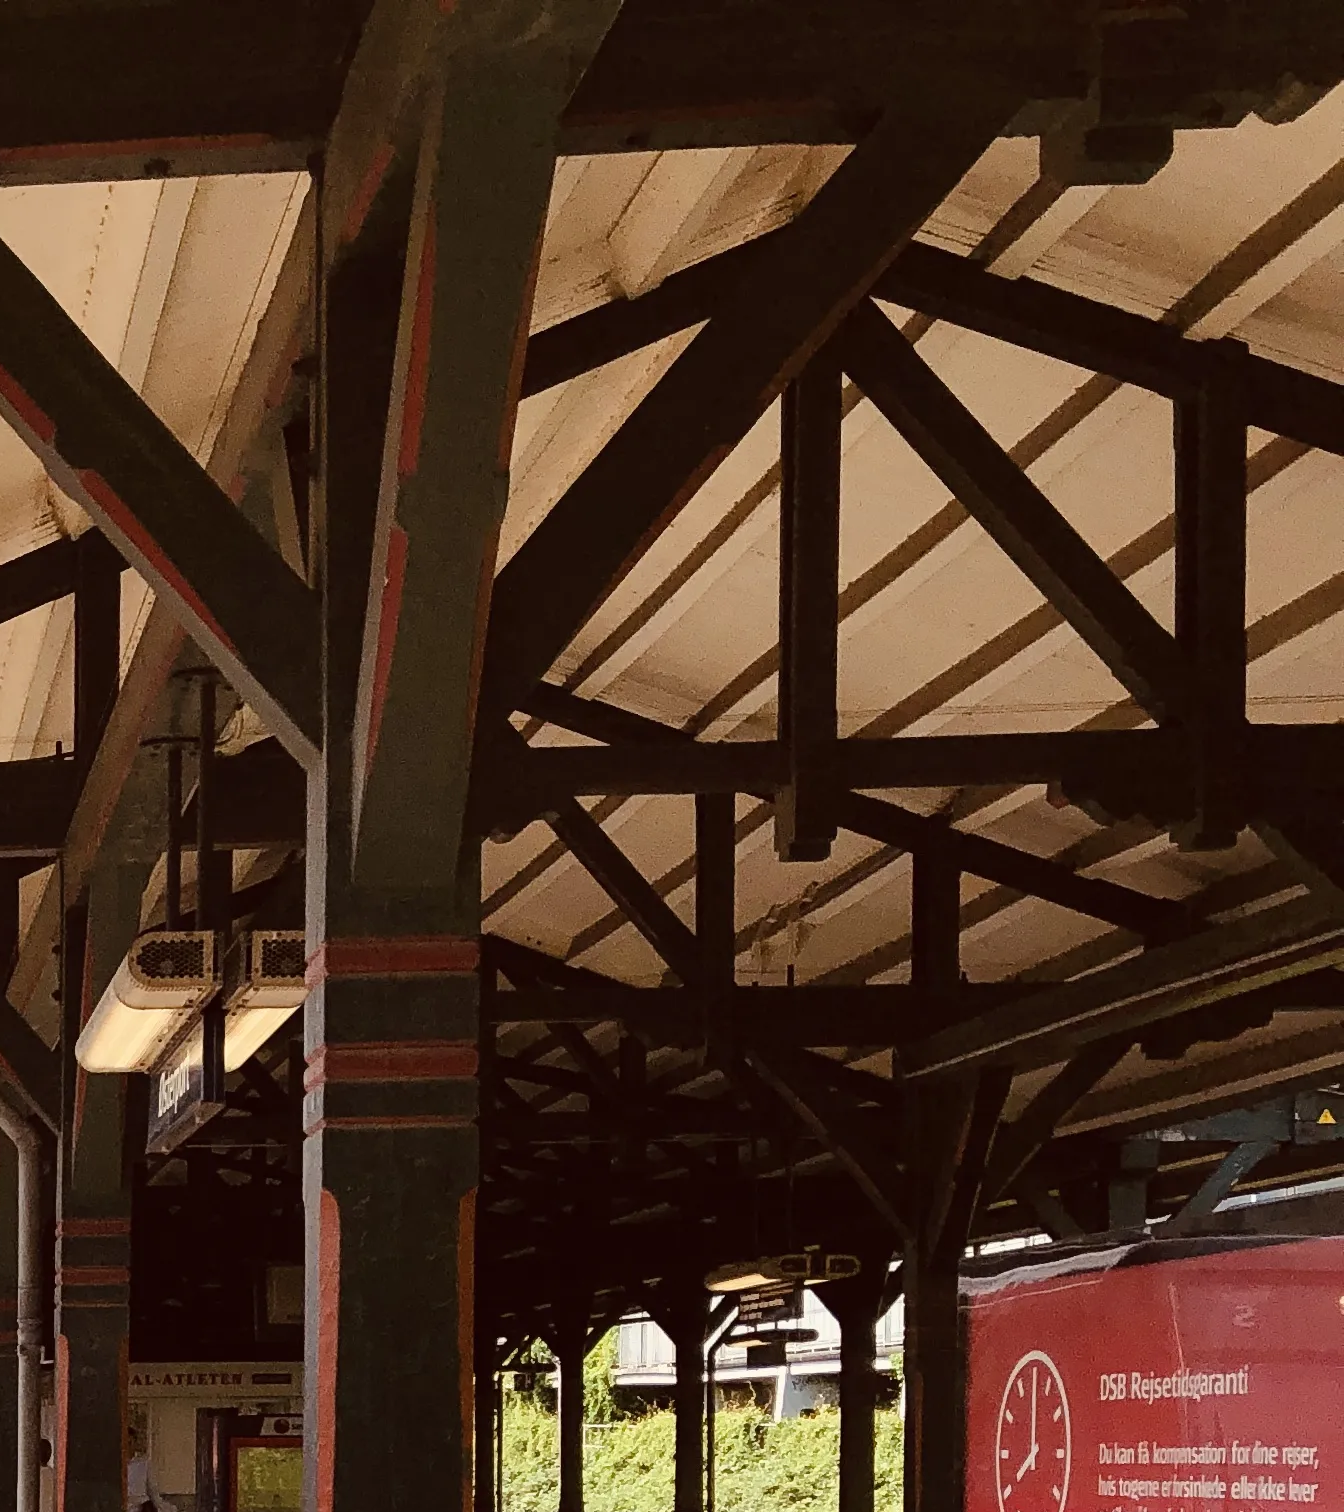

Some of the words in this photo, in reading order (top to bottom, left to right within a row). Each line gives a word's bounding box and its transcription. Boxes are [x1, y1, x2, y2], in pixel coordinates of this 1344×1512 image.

[1100, 1373, 1127, 1400] DSB
[1131, 1364, 1249, 1405] Rejsetidsgaranti
[1099, 1443, 1113, 1464] Du
[1114, 1442, 1135, 1464] kan
[1138, 1440, 1150, 1464] få
[1231, 1440, 1251, 1464] for
[1119, 1478, 1160, 1501] togene
